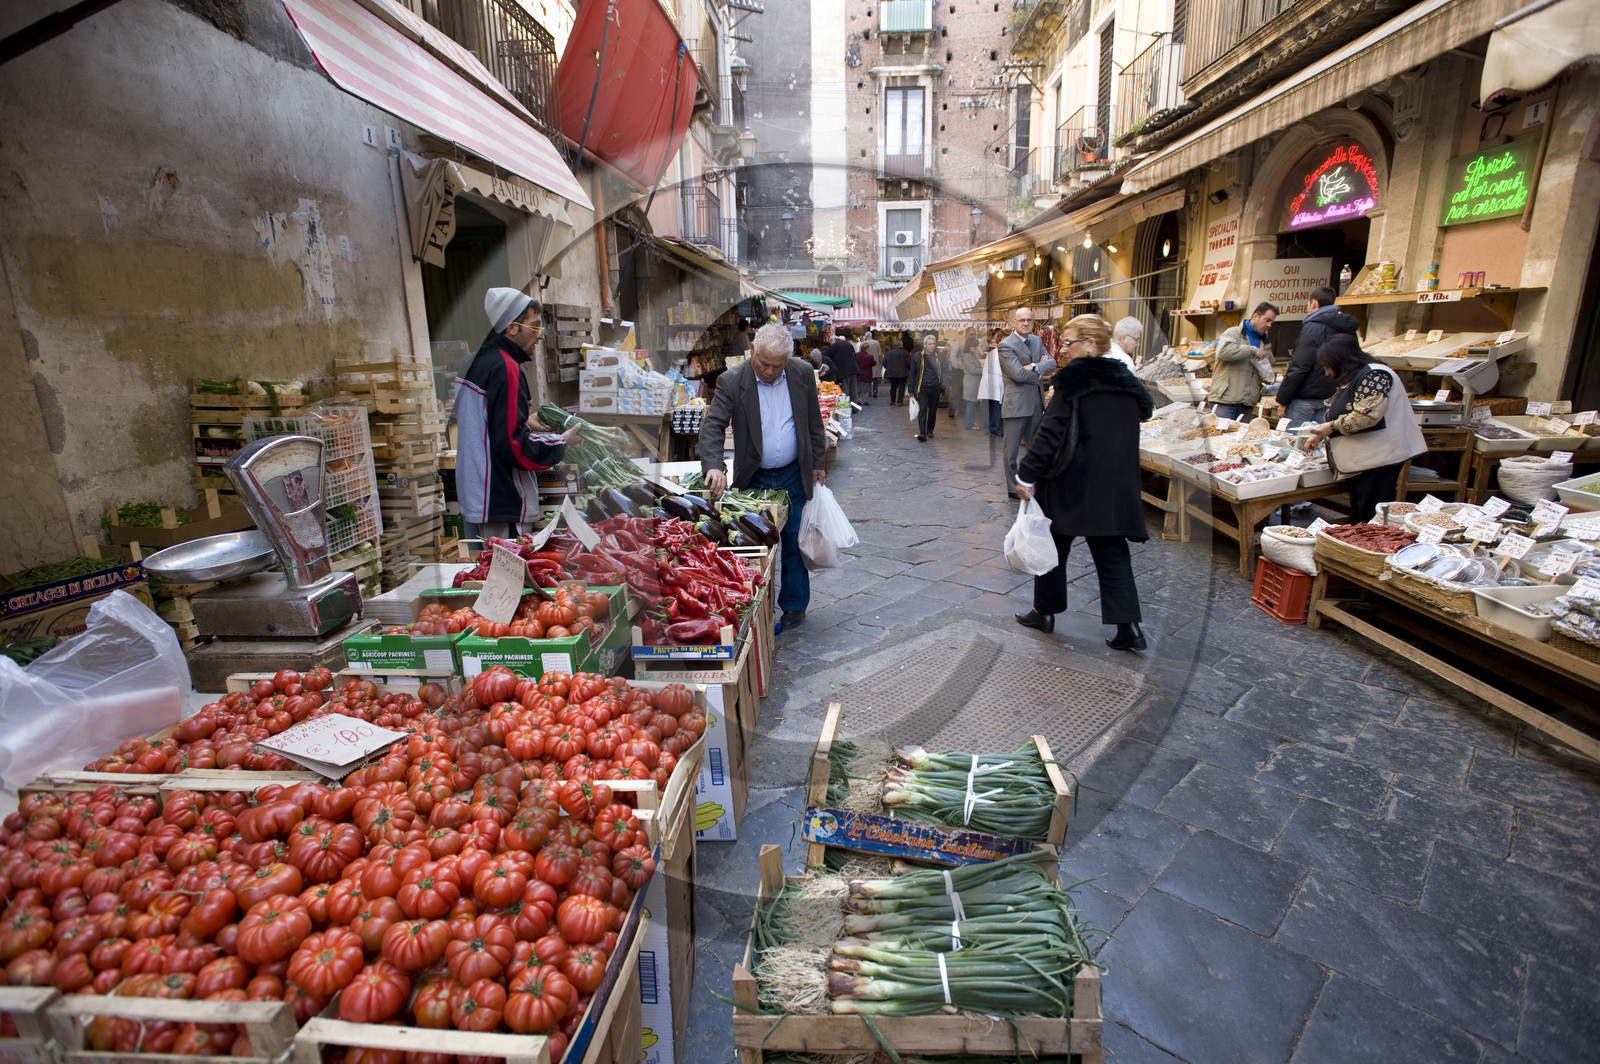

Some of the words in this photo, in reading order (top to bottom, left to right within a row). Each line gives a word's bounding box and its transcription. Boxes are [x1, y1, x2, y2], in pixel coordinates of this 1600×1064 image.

[492, 176, 539, 209] PANIFICIO
[935, 267, 965, 281] FETTINE
[1283, 265, 1300, 275] QUI
[945, 275, 975, 289] VITELLO
[1254, 278, 1300, 289] PRODOTTI
[1302, 277, 1328, 288] TIPICI
[1269, 291, 1310, 302] SICILIANI
[879, 321, 911, 329] Centro
[914, 321, 961, 329] Salumeria
[8, 584, 68, 611] ORTAGGI
[68, 580, 82, 596] DI
[82, 571, 123, 592] SICILIA
[652, 646, 680, 655] FRUTTA
[689, 646, 718, 654] BRONTE
[848, 821, 936, 850] L'Ortolano
